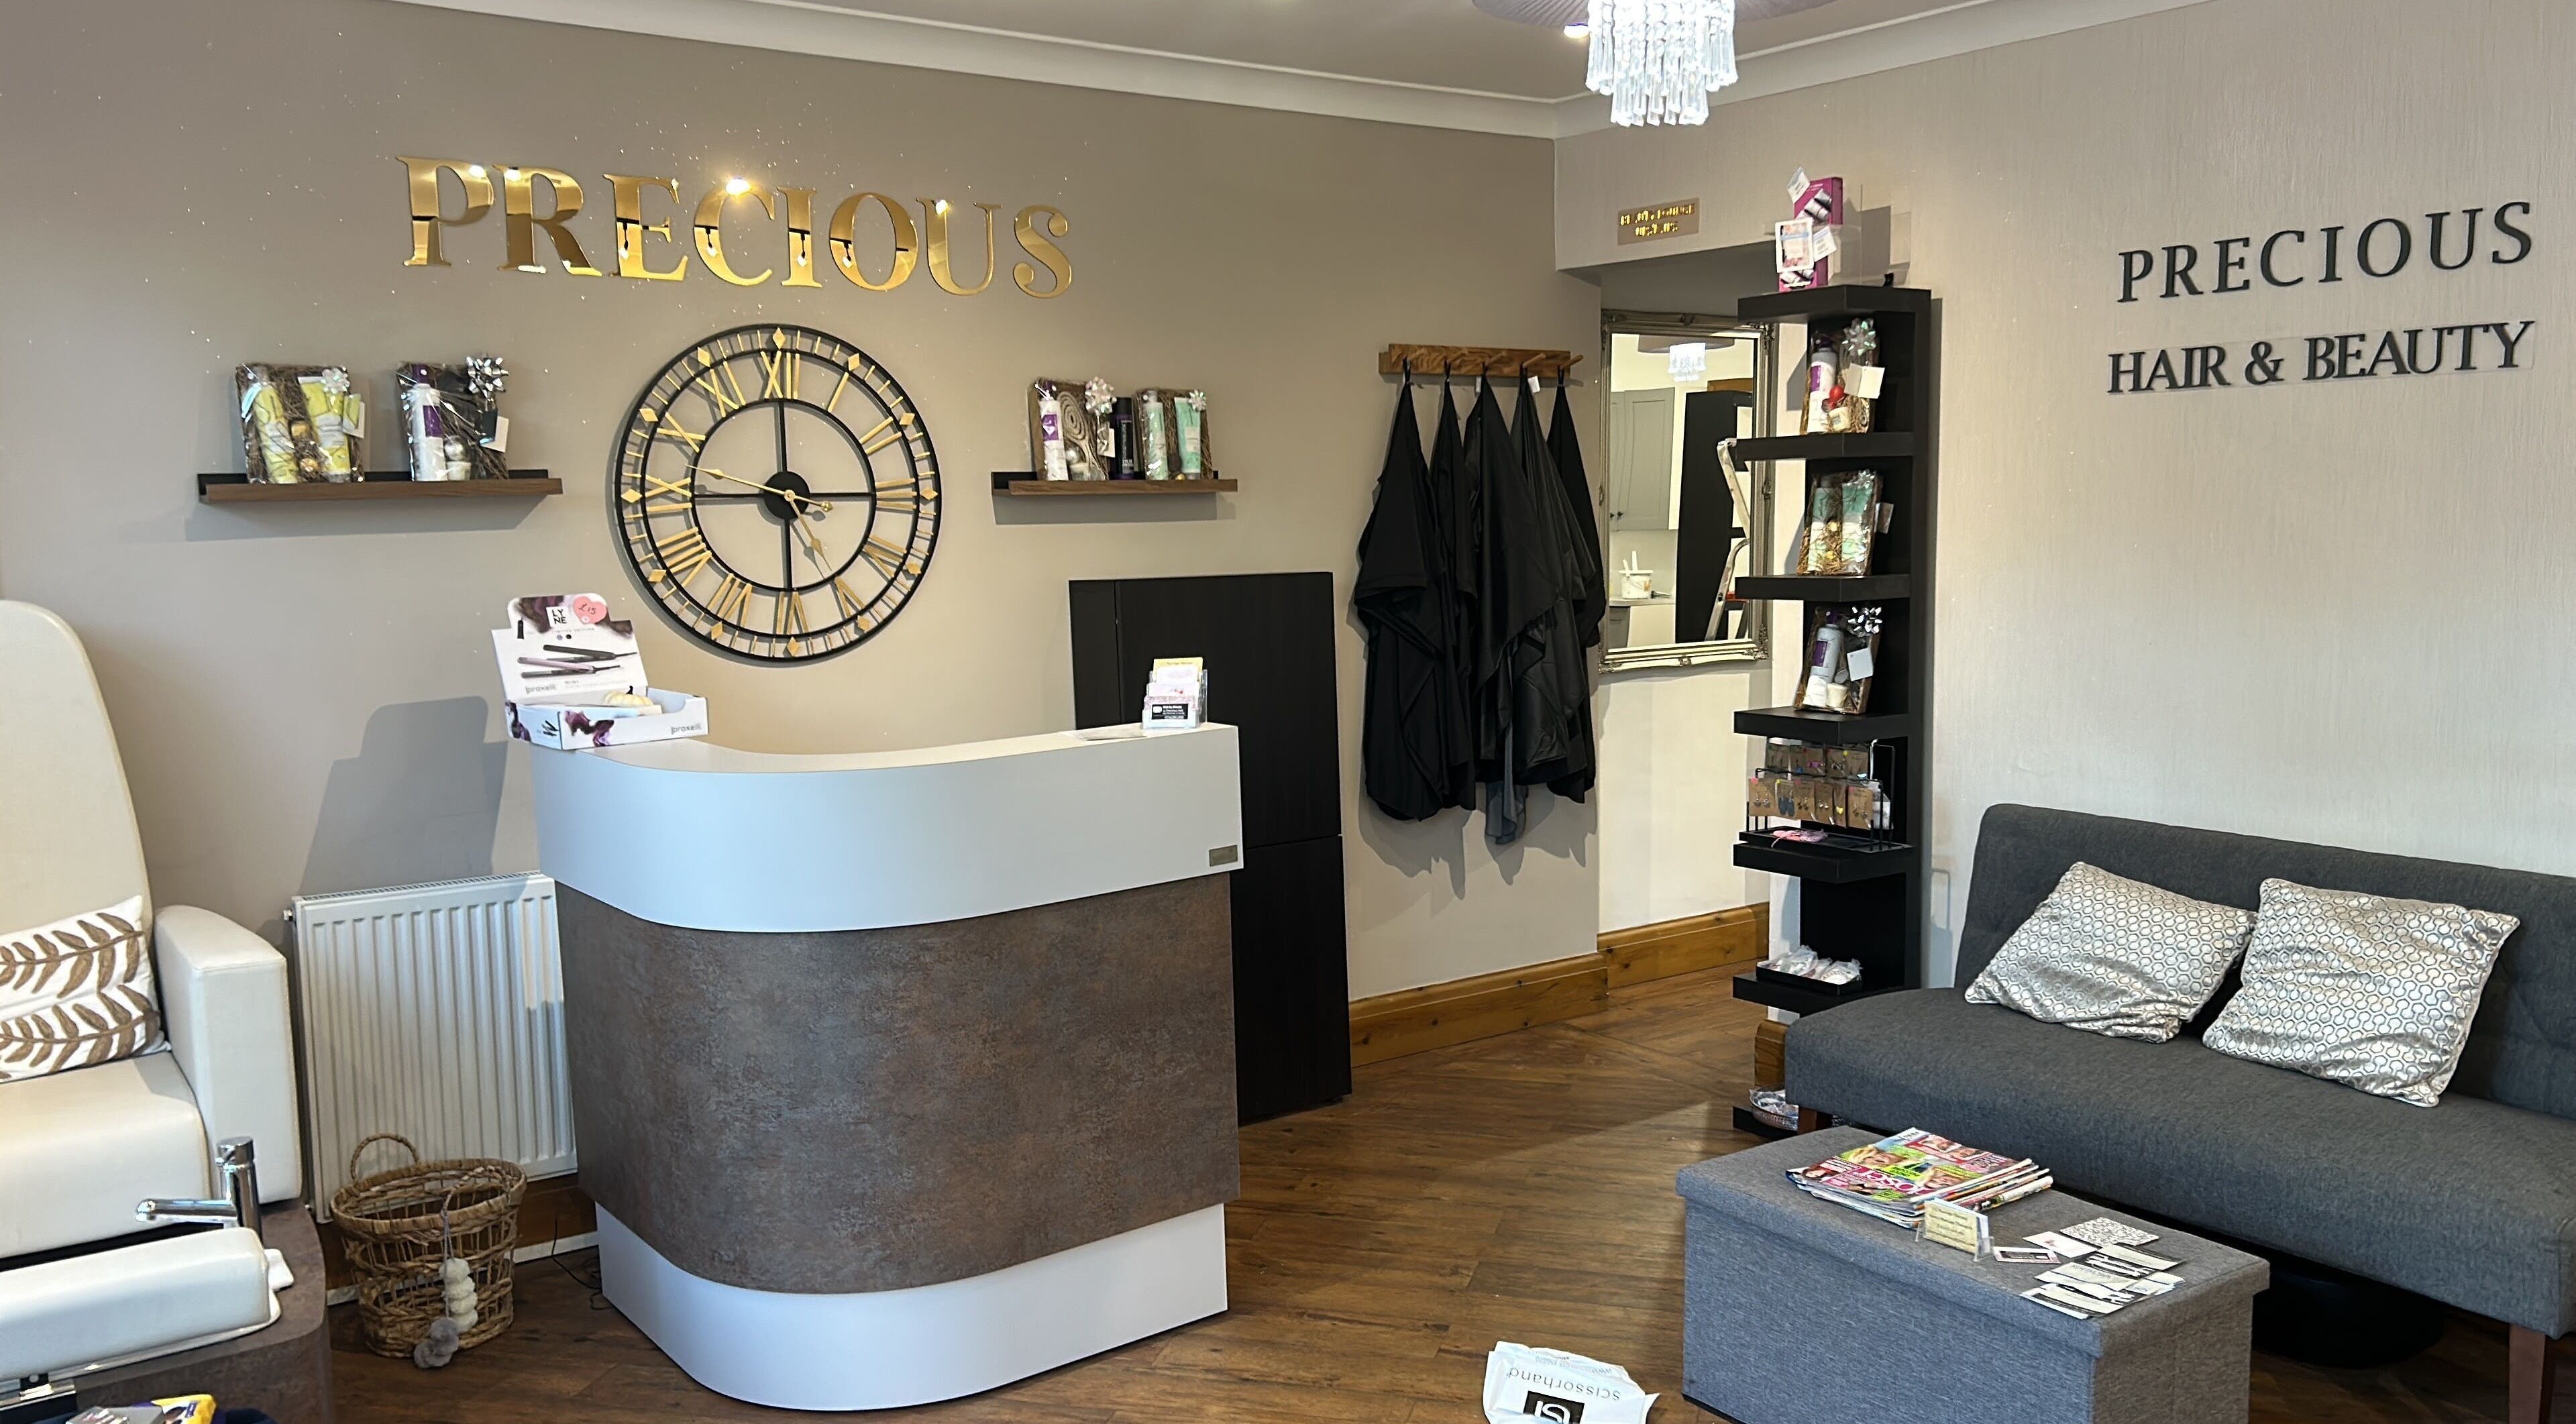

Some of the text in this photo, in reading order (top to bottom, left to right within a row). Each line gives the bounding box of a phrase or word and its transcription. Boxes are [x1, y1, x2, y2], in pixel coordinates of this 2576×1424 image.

[395, 155, 1073, 300] PRECIOUS
[2117, 201, 2532, 303] PRECIOUS
[2106, 320, 2535, 394] HAIR & BEAUTY
[1508, 1367, 1621, 1401] scissorhand
